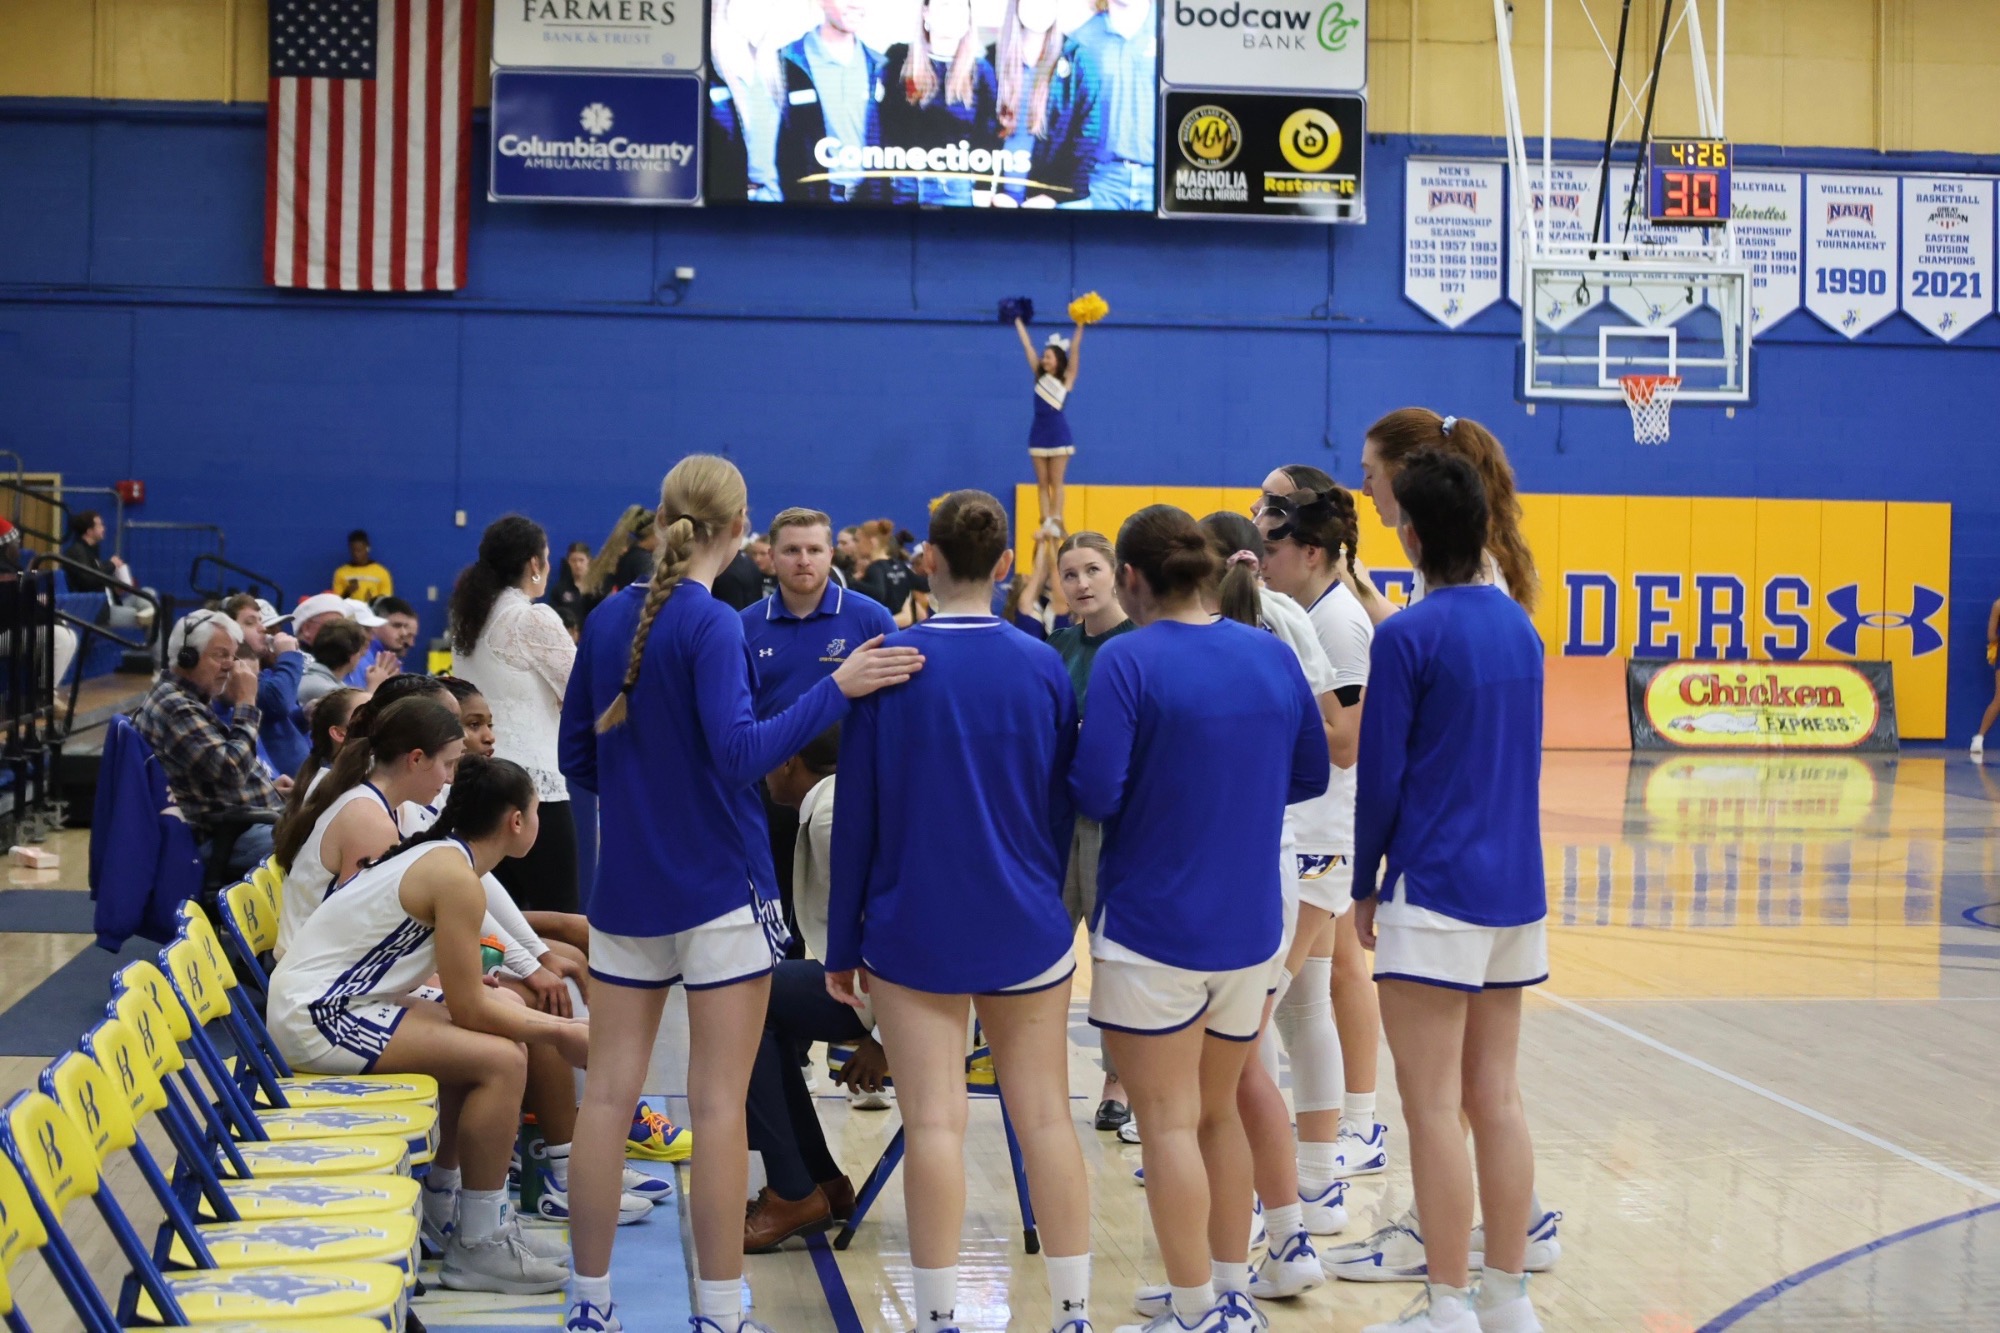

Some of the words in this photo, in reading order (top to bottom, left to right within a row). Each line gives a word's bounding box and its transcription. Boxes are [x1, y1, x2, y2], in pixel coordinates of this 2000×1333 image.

[523, 0, 675, 25] FARMERS
[1175, 0, 1311, 30] bodcaw
[543, 31, 583, 43] BANK
[588, 32, 599, 43] &
[605, 33, 652, 45] TRUST
[1243, 34, 1307, 50] BANK
[814, 136, 1032, 173] Connections
[1671, 143, 1726, 167] 4:26
[524, 157, 610, 171] AMBULANCE
[615, 159, 672, 172] SERVICE
[1438, 166, 1471, 176] MEN'S
[1176, 169, 1248, 190] MAGNOLIA
[1420, 177, 1488, 188] BASKETBALL
[1820, 184, 1884, 196] VOLLEYBALL
[1932, 183, 1964, 193] MEN'S
[1176, 186, 1203, 201] GLASS
[1205, 188, 1213, 201] &
[1213, 187, 1249, 203] MIRROR
[1430, 190, 1476, 209] NAIA
[1665, 173, 1717, 217] 30
[1915, 193, 1980, 205] BASKETBALL
[1828, 203, 1872, 221] NAIA
[1928, 212, 1969, 223] AMERICAN
[1414, 215, 1493, 227] CHAMPIONSHIP
[1430, 228, 1476, 237] SEASONS
[1825, 228, 1877, 240] NATIONAL
[1924, 233, 1970, 243] EASTERN
[1409, 239, 1436, 250] 1934
[1440, 240, 1466, 251] 1957
[1816, 239, 1887, 251] TOURNAMENT
[1926, 245, 1969, 254] DIVISION
[1409, 253, 1436, 265] 1935
[1770, 250, 1797, 262] 1990
[1918, 255, 1976, 266] CHAMPIONS
[1770, 264, 1797, 275] 1994
[1815, 267, 1887, 295] 1990
[1911, 270, 1982, 299] 2021
[1440, 282, 1465, 293] 1971
[1679, 674, 1845, 708] Chicken
[1765, 715, 1850, 733] EXPRESS
